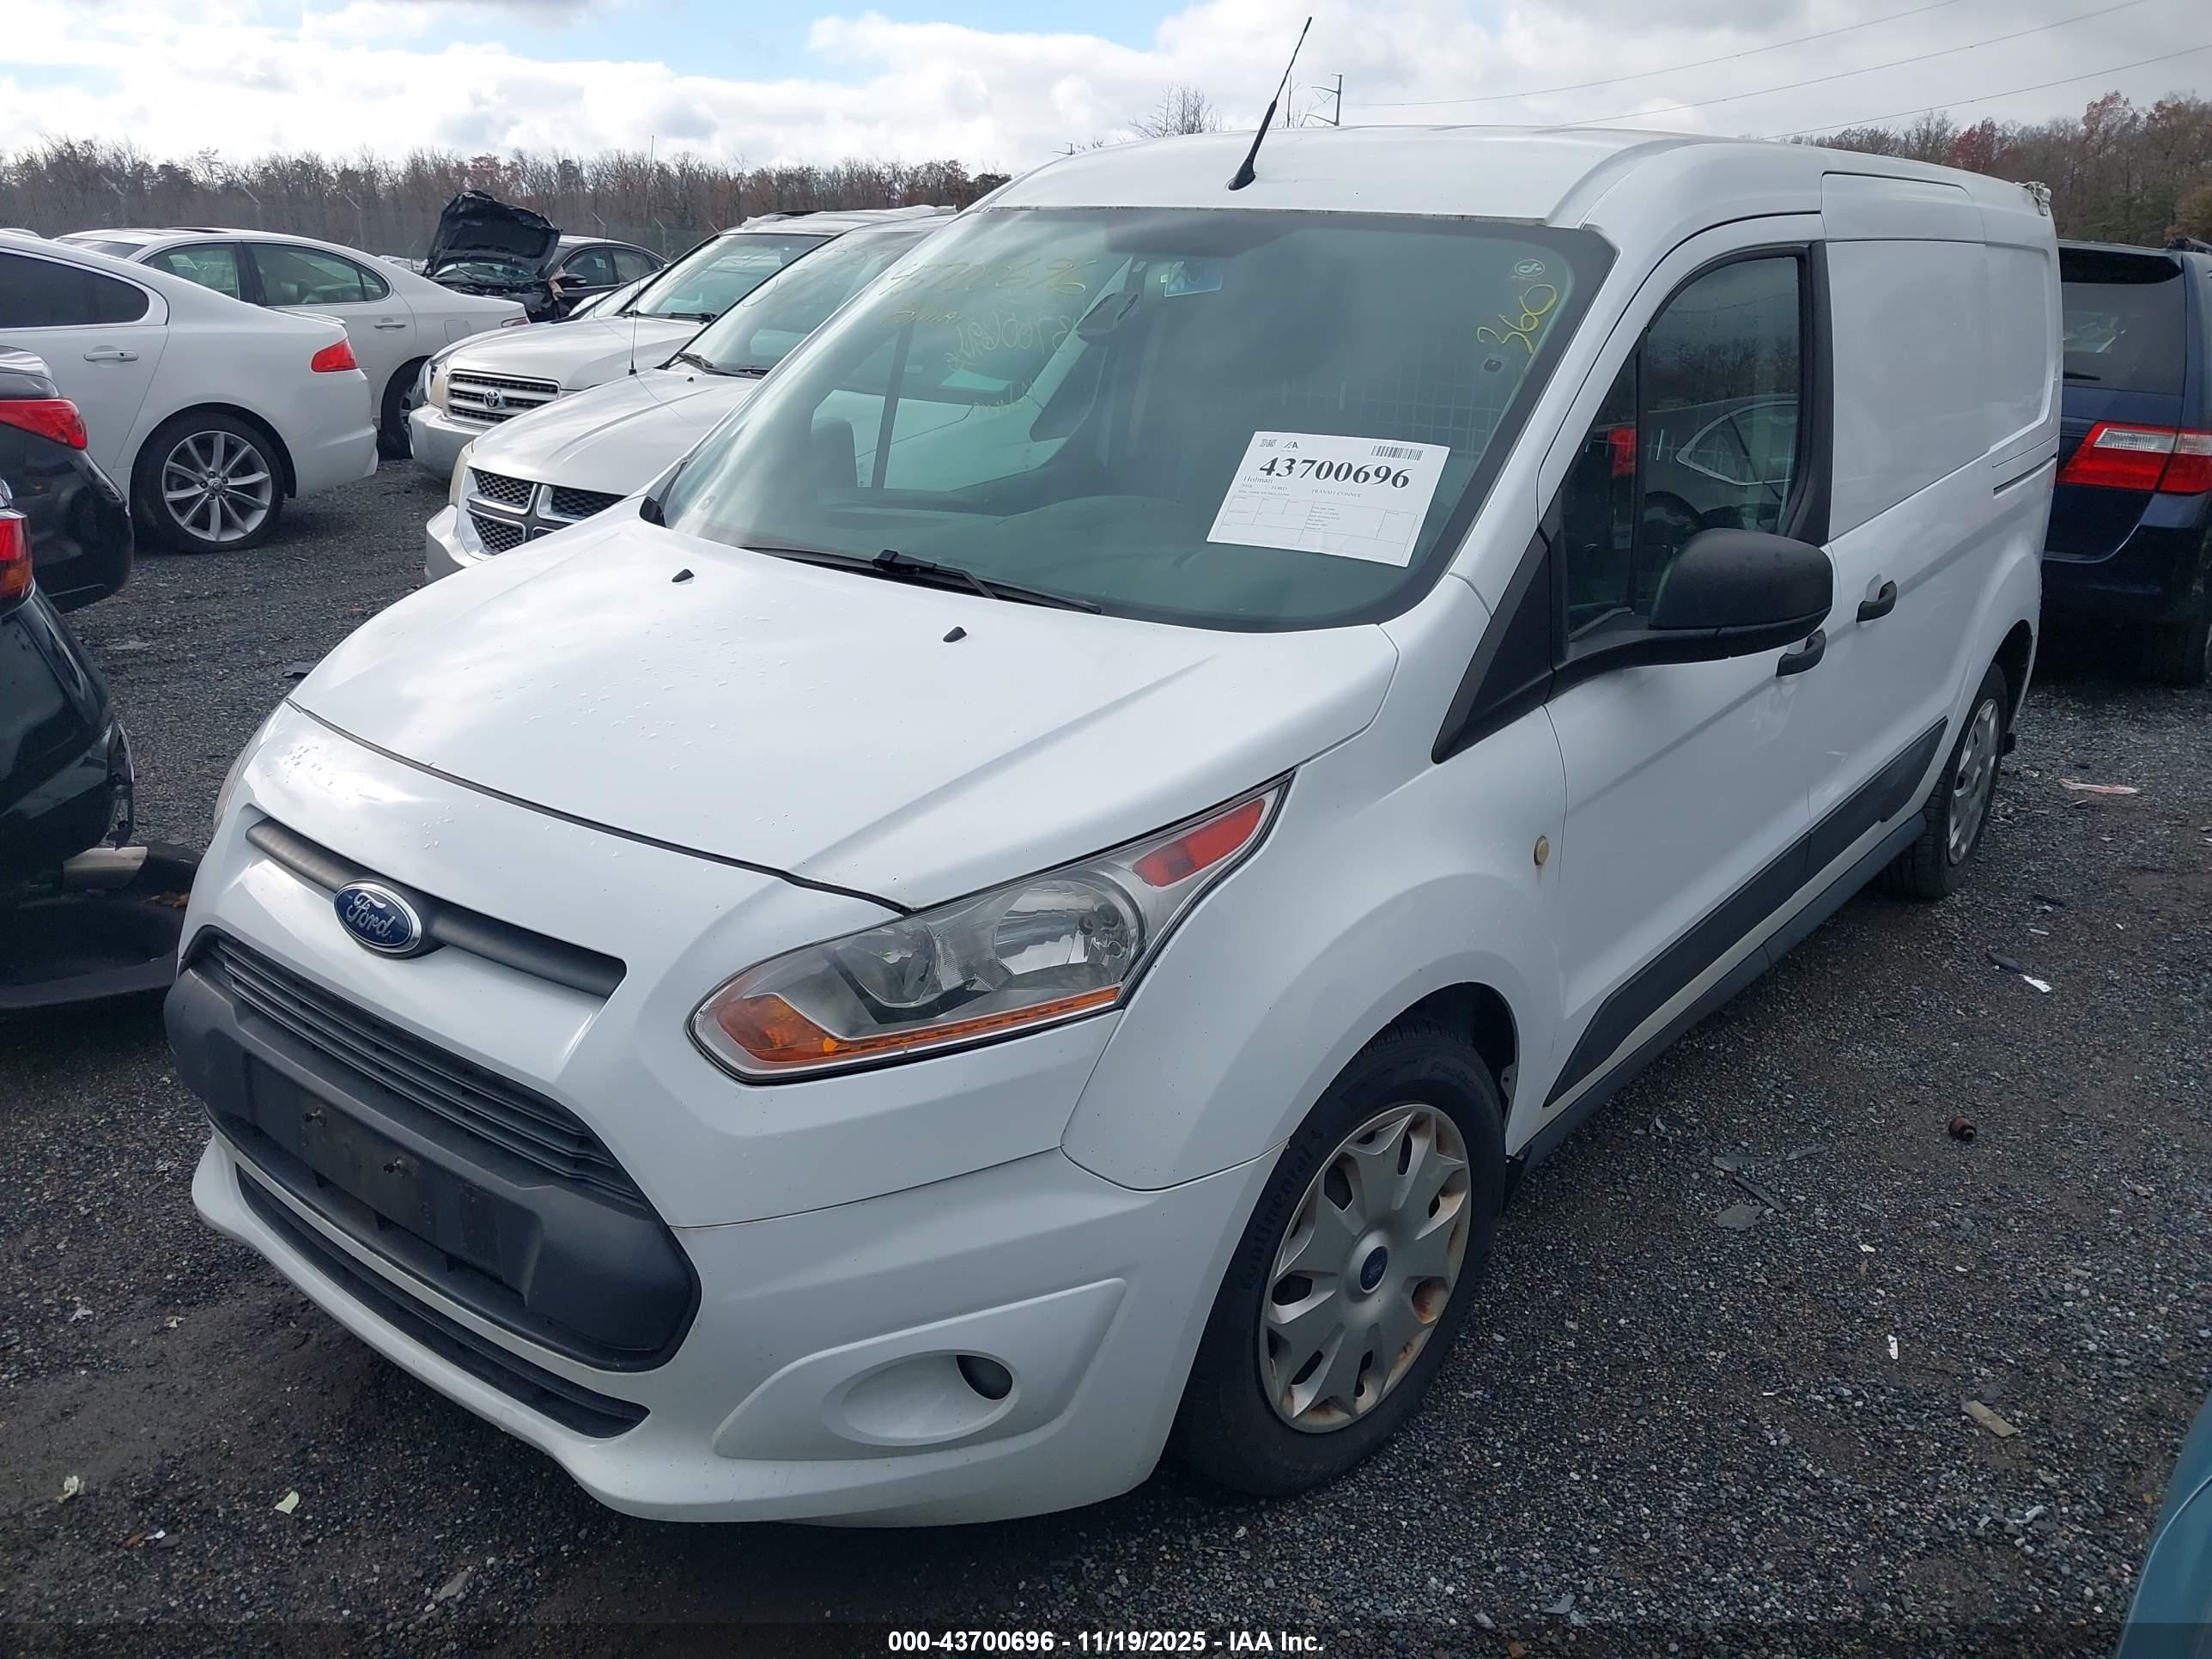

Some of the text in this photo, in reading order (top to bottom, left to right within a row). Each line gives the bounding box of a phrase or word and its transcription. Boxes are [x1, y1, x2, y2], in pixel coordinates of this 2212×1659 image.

[1477, 283, 1558, 355] 360
[1243, 475, 1273, 484] Holman
[1259, 457, 1415, 489] 43700696
[345, 892, 396, 939] Ford
